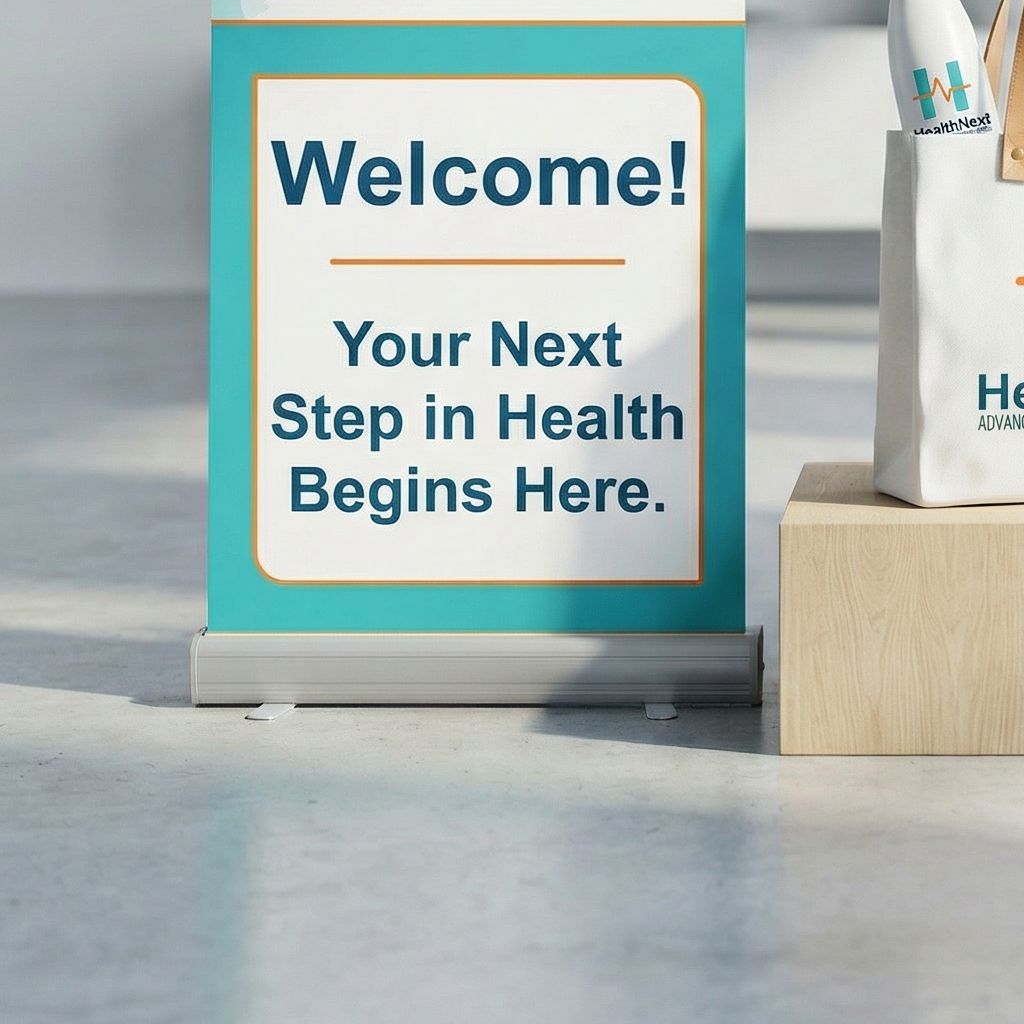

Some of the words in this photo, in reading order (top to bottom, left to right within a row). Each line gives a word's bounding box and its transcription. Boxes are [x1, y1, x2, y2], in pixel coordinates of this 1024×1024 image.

[271, 140, 686, 207] Welcome!
[332, 321, 472, 368] Your
[491, 321, 623, 368] Next
[271, 393, 403, 452] Step
[426, 393, 474, 440] in
[499, 393, 684, 441] Health
[291, 466, 493, 525] Begins
[516, 466, 665, 513] Here.
